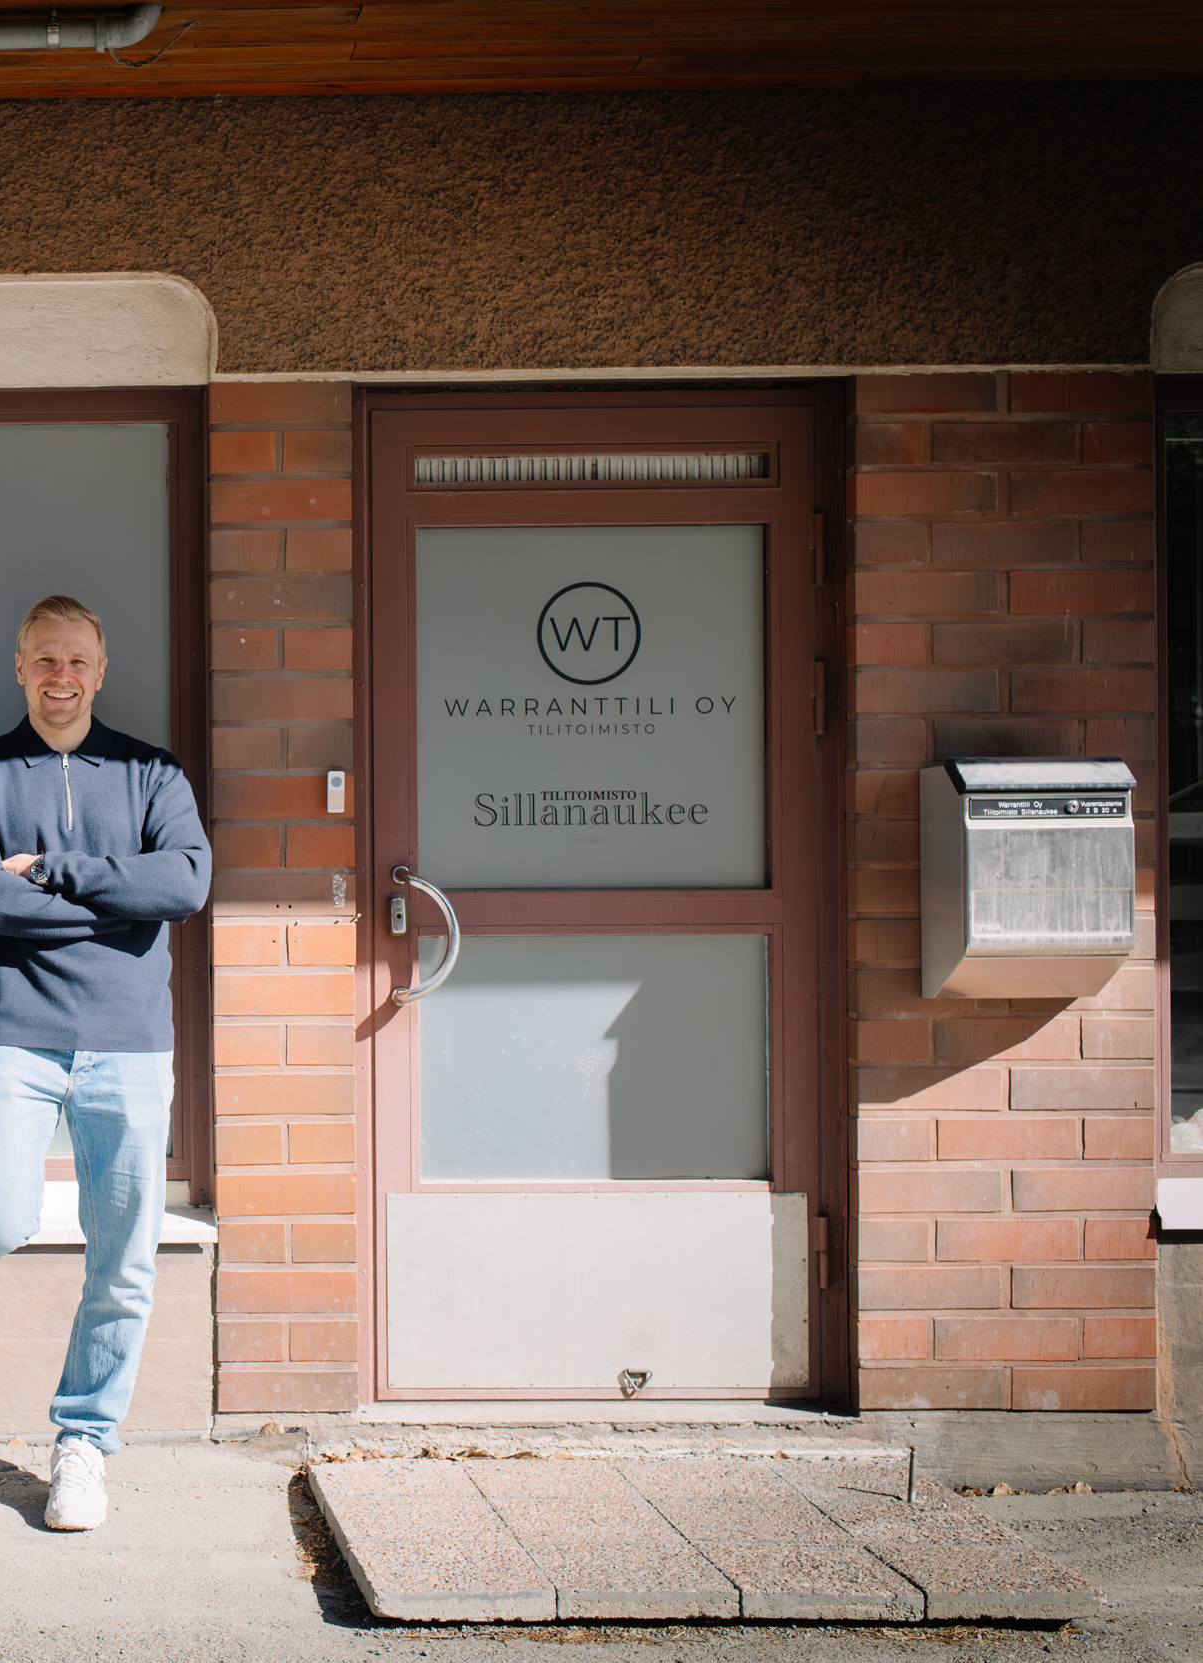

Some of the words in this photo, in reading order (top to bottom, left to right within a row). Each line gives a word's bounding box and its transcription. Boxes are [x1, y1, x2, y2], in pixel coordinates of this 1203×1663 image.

[550, 616, 631, 652] WT
[444, 697, 674, 716] WARRANTTILI
[695, 696, 737, 714] OY
[528, 723, 656, 735] TILITOIMISTO
[540, 790, 637, 801] TILITOIMISTO
[474, 792, 709, 826] Sillanaukee
